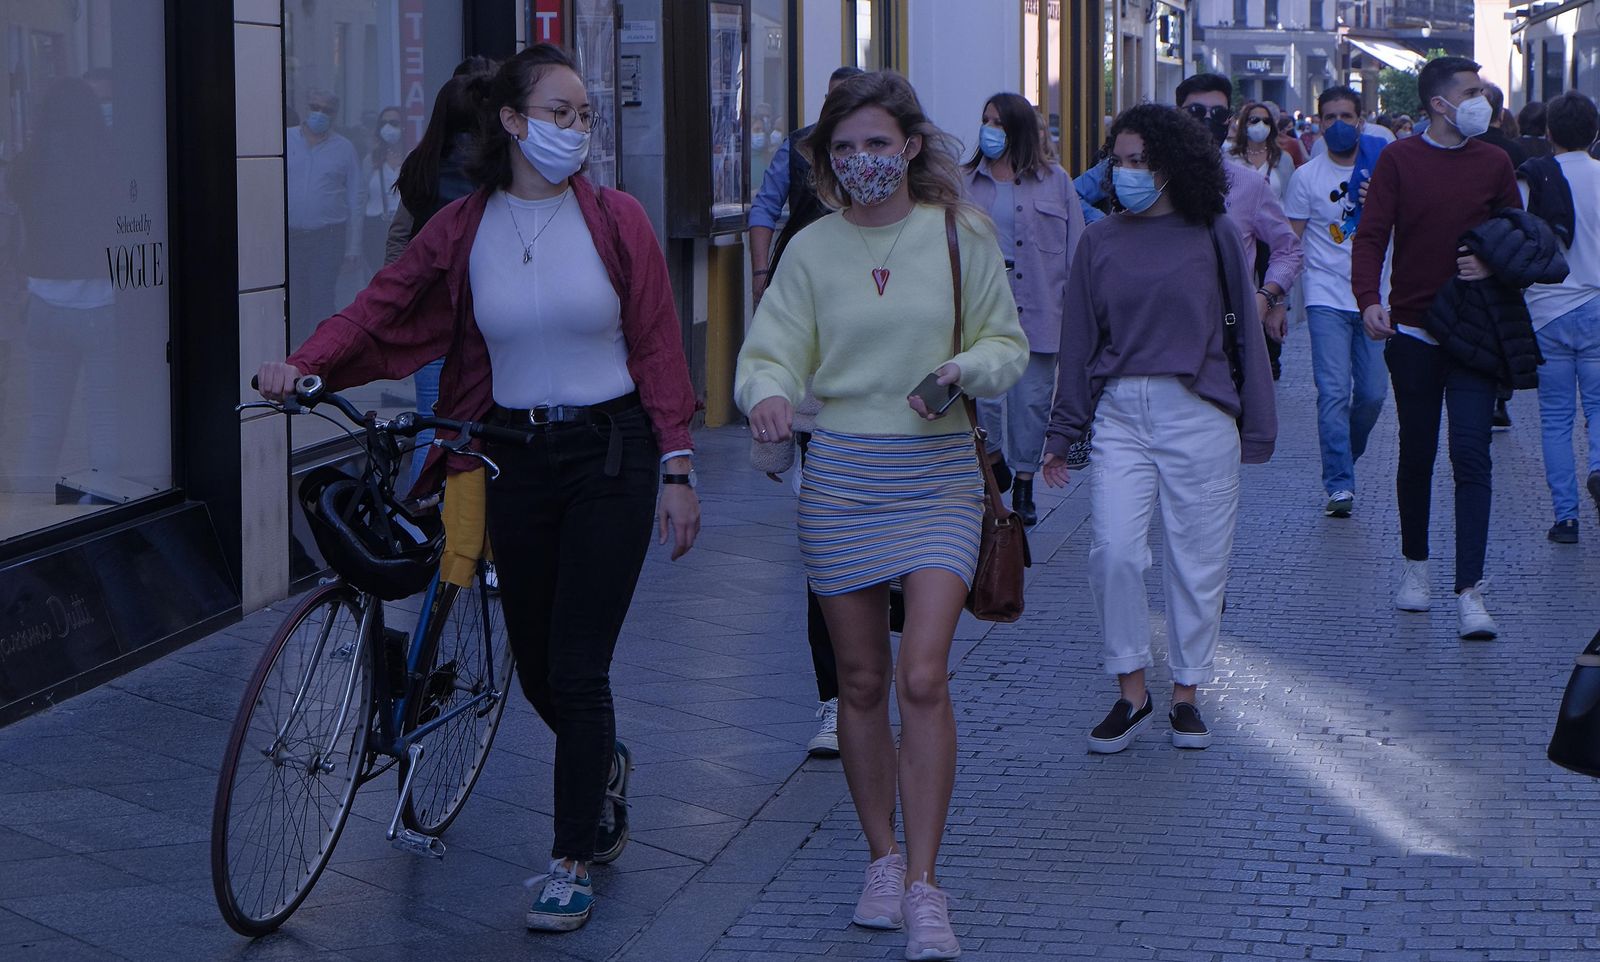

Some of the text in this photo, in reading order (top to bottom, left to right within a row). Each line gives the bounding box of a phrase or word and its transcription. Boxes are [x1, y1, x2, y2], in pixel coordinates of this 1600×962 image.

[535, 11, 558, 39] T
[116, 212, 152, 236] Selected by
[106, 242, 164, 292] VOGUE
